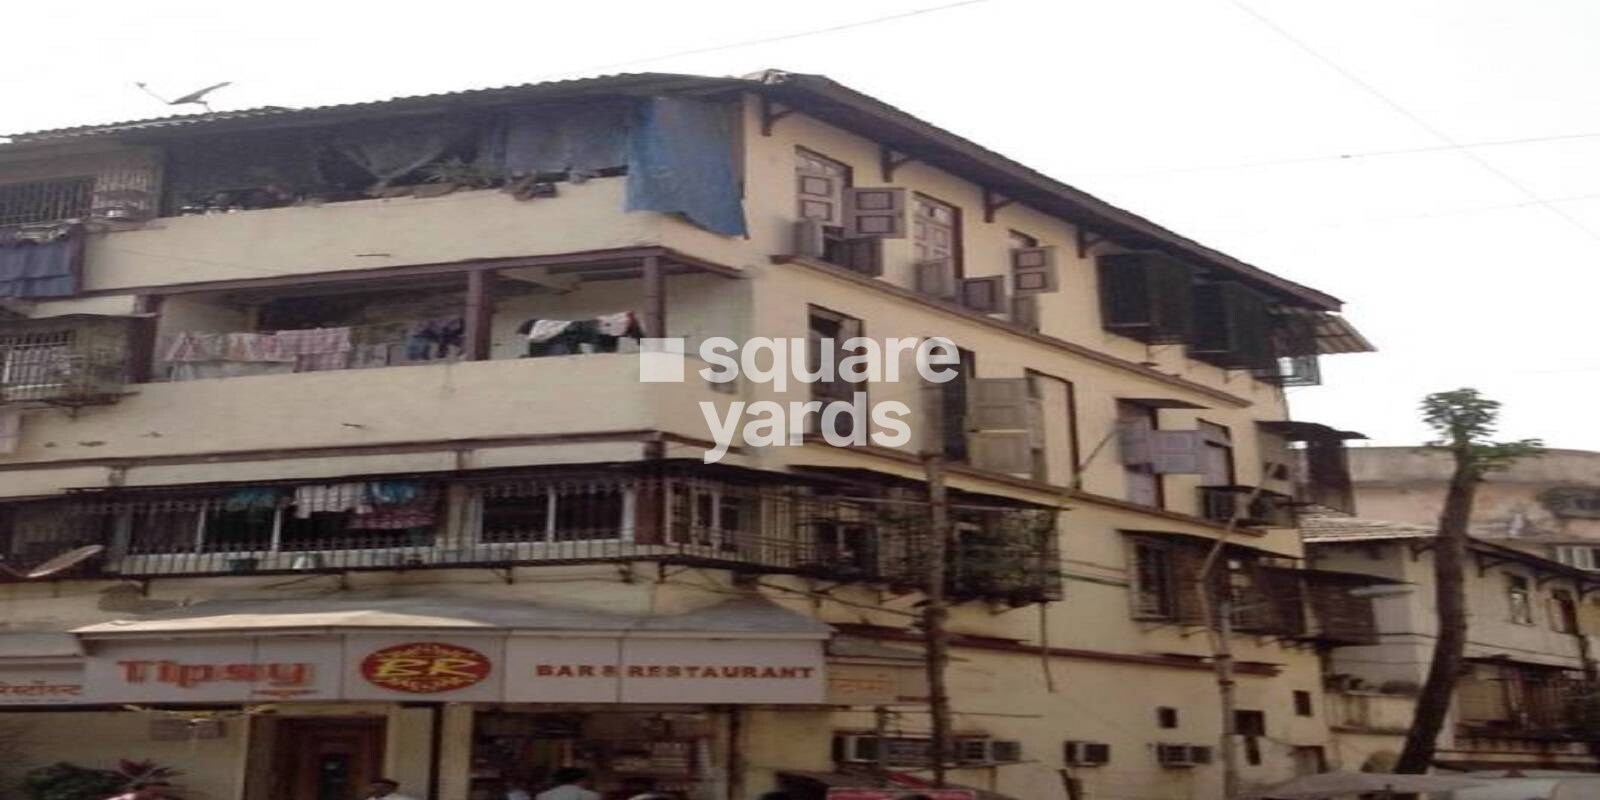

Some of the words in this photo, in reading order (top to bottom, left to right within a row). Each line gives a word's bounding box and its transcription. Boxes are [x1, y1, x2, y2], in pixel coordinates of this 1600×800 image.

[116, 659, 309, 688] Tipsy
[536, 665, 595, 677] BAR
[627, 666, 816, 679] RESTAURANT
